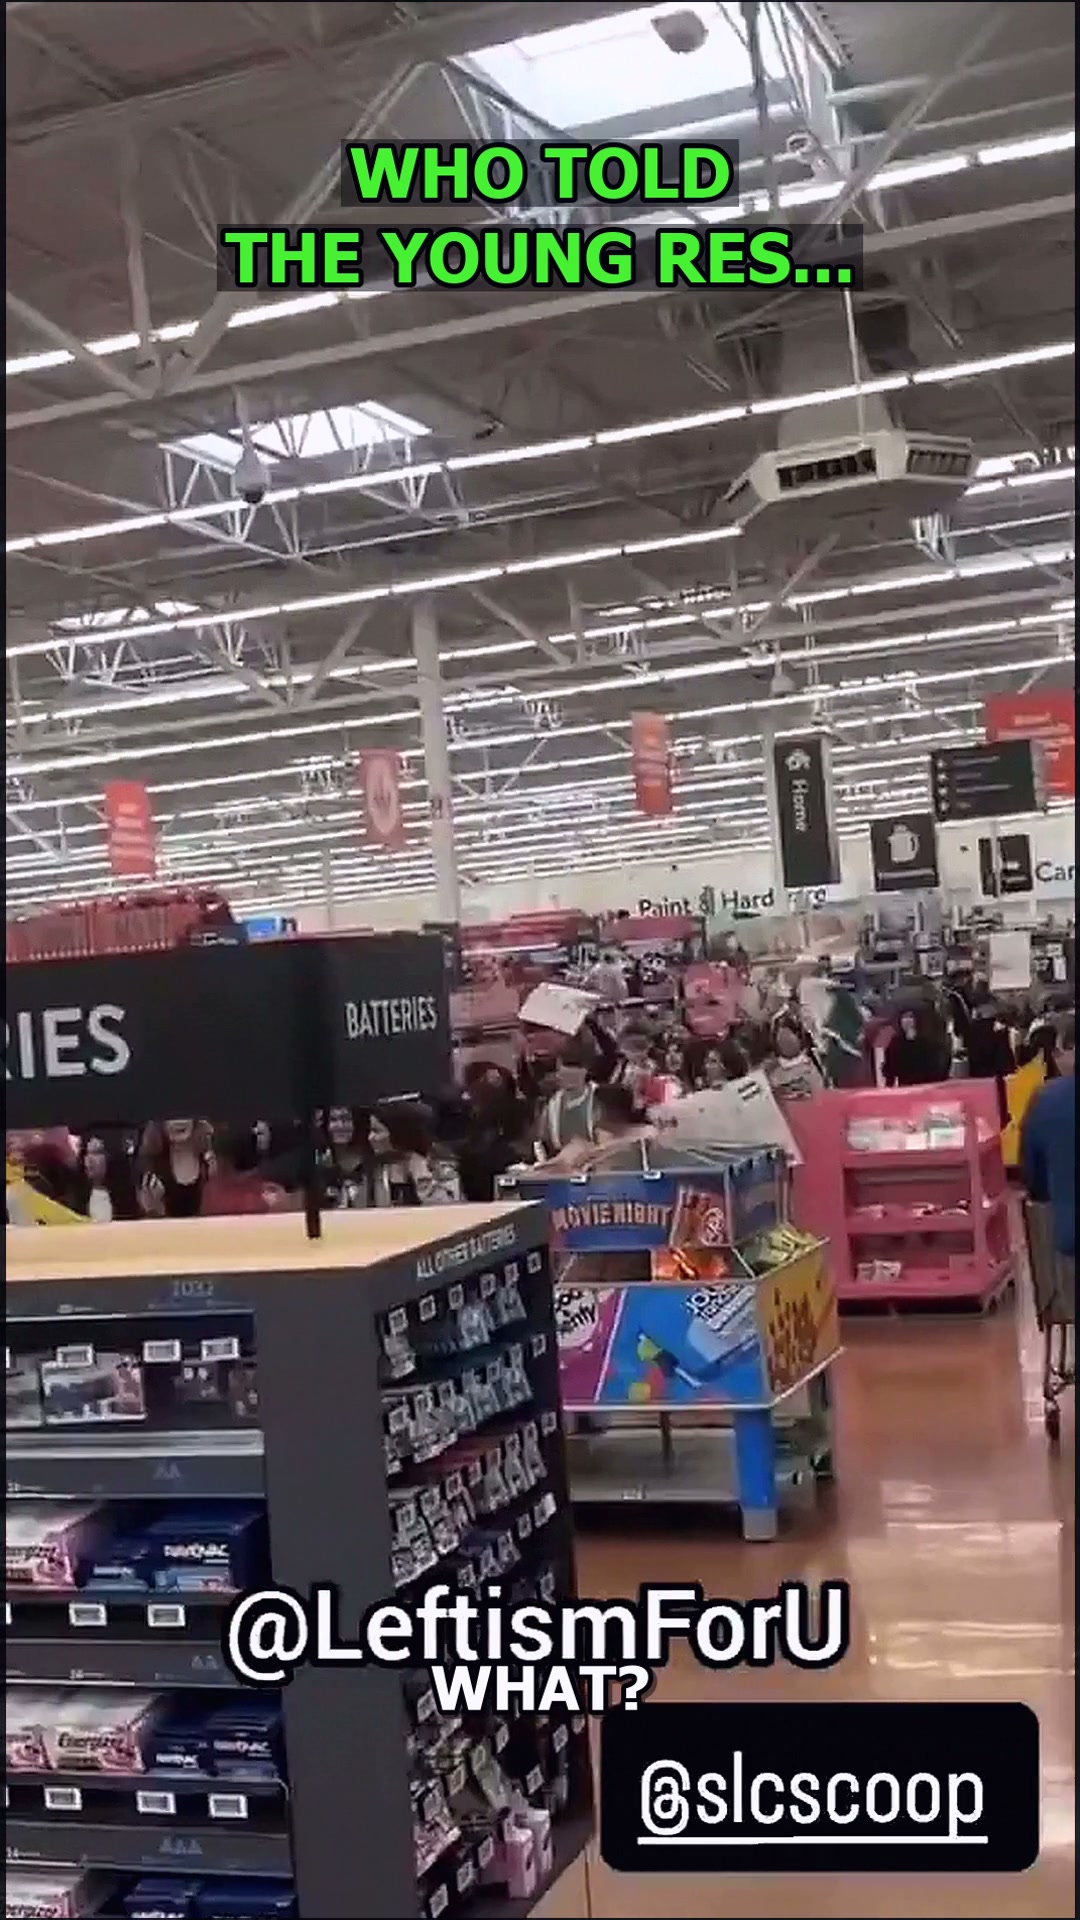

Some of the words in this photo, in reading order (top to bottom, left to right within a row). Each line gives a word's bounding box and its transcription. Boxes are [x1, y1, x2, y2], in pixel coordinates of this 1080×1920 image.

[791, 778, 809, 832] Home
[638, 896, 697, 917] Paint
[345, 997, 438, 1039] BATTERIES
